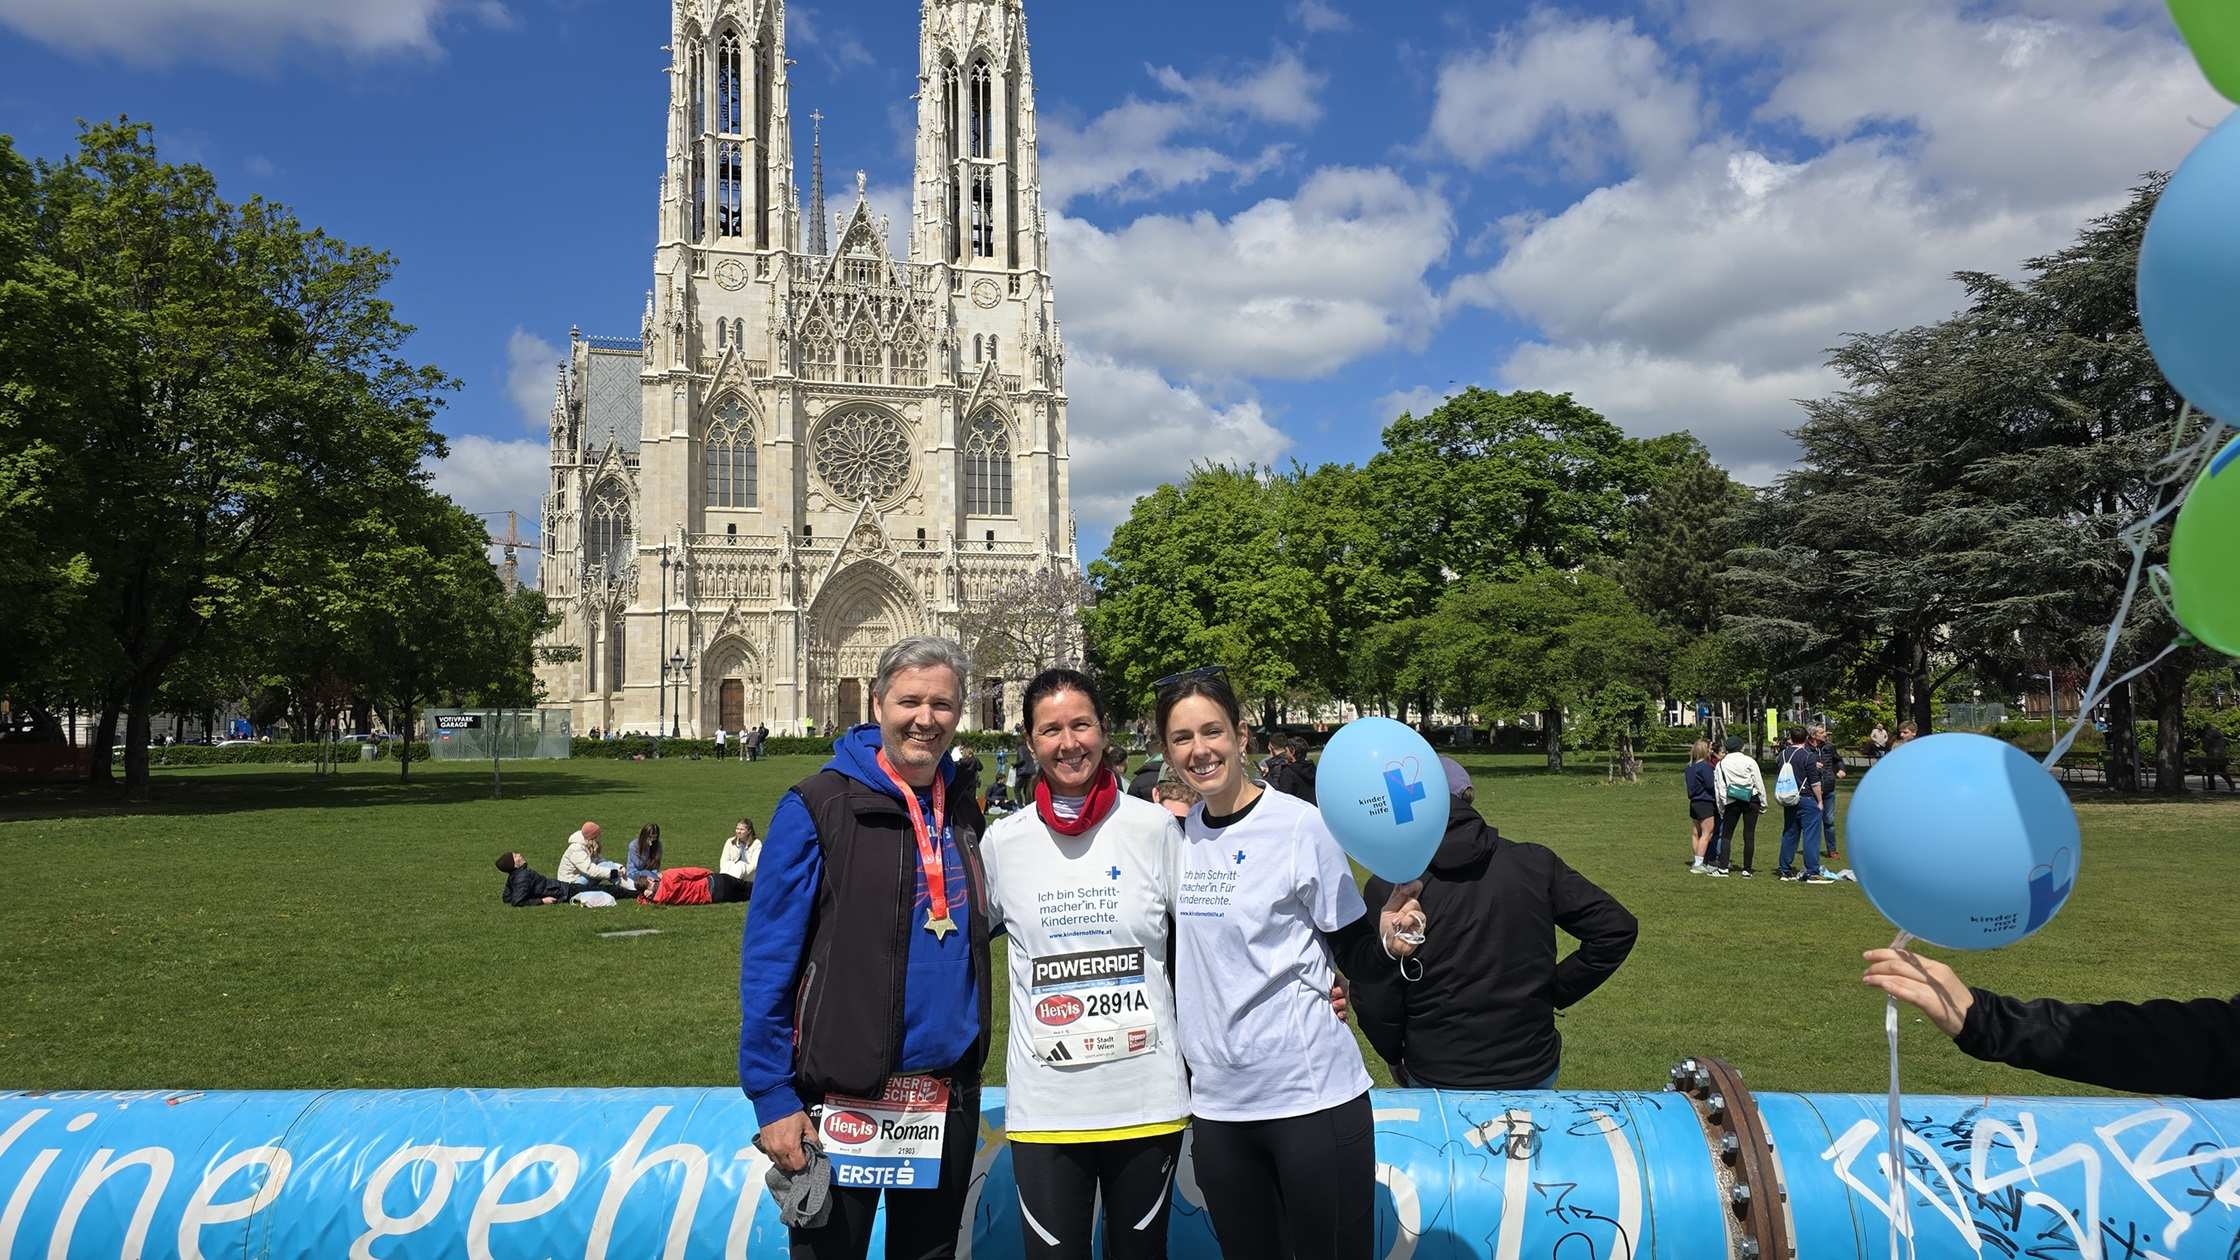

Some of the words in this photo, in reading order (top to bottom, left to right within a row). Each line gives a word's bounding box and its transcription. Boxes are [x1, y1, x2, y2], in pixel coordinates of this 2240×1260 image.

[1358, 795, 1385, 805] kinder
[1369, 807, 1388, 816] hilfe
[1207, 870, 1241, 880] Schritt-
[1220, 883, 1236, 893] Für
[1038, 892, 1053, 902] Ich
[1057, 890, 1074, 900] bin
[1077, 886, 1120, 898] Schritt-
[1100, 899, 1118, 909] Für
[1041, 913, 1118, 927] Kinderrechte.
[1970, 914, 2017, 923] kinder
[1994, 919, 2017, 927] not
[1049, 929, 1111, 939] www.kindernothilfe.at
[1036, 954, 1138, 980] POWERADE
[1040, 1002, 1080, 1019] Hervis
[1087, 990, 1149, 1016] 2891A
[829, 1116, 873, 1137] Hervis
[880, 1119, 939, 1140] Roman
[898, 1147, 915, 1155] 21903
[838, 1164, 895, 1185] ERSTE
[0, 1109, 292, 1260] ine
